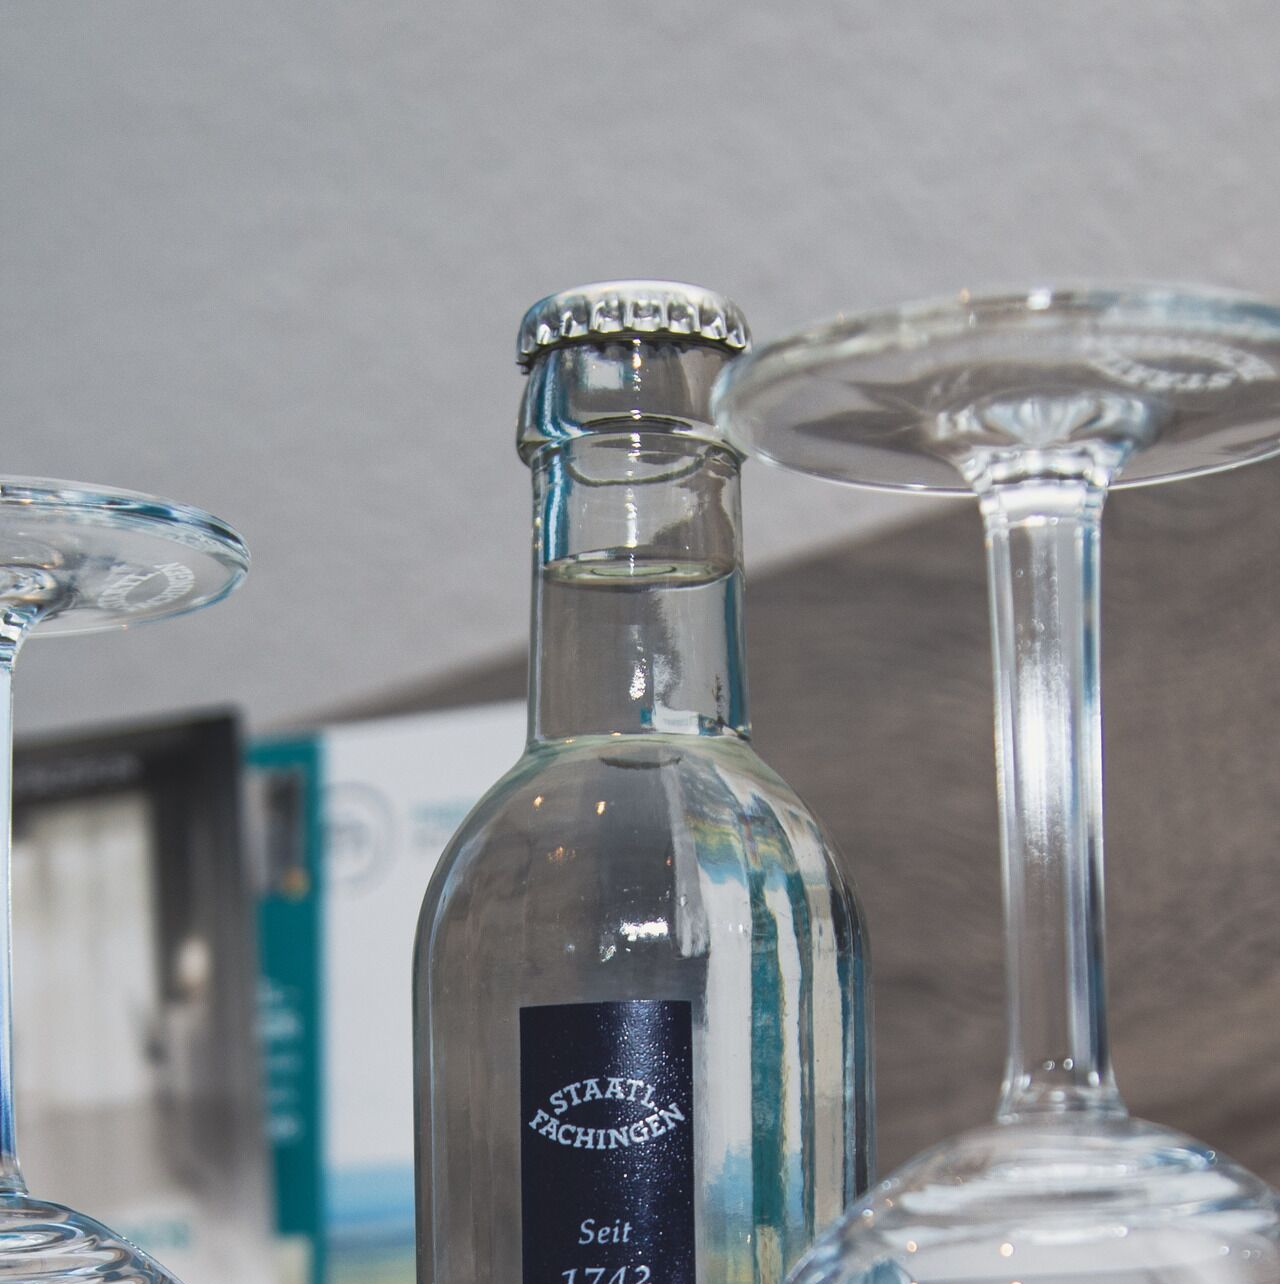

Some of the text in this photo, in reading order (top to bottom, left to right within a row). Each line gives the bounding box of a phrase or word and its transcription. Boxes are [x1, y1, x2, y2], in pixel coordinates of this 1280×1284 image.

[549, 1077, 659, 1116] STAATL.
[528, 1102, 686, 1150] FACHINGEN
[578, 1218, 633, 1245] Seit
